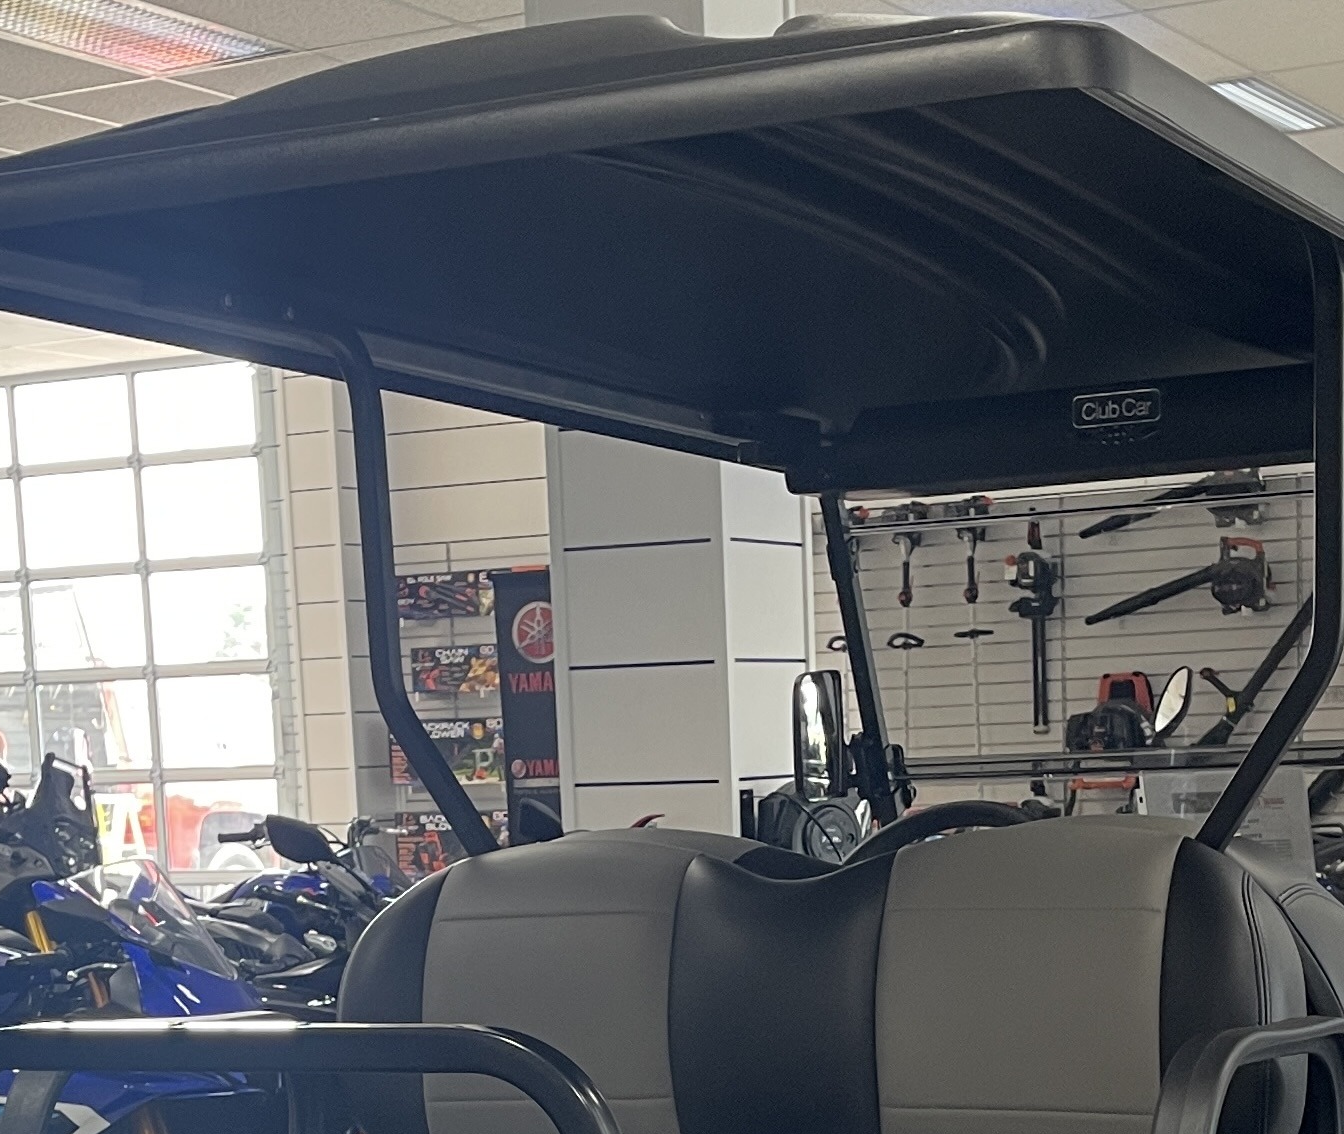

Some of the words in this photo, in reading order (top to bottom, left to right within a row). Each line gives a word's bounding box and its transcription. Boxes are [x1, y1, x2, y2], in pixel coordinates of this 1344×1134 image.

[1081, 400, 1120, 421] Club
[1121, 397, 1153, 417] Car
[423, 721, 470, 731] ACKPACK
[430, 729, 465, 739] LOWER
